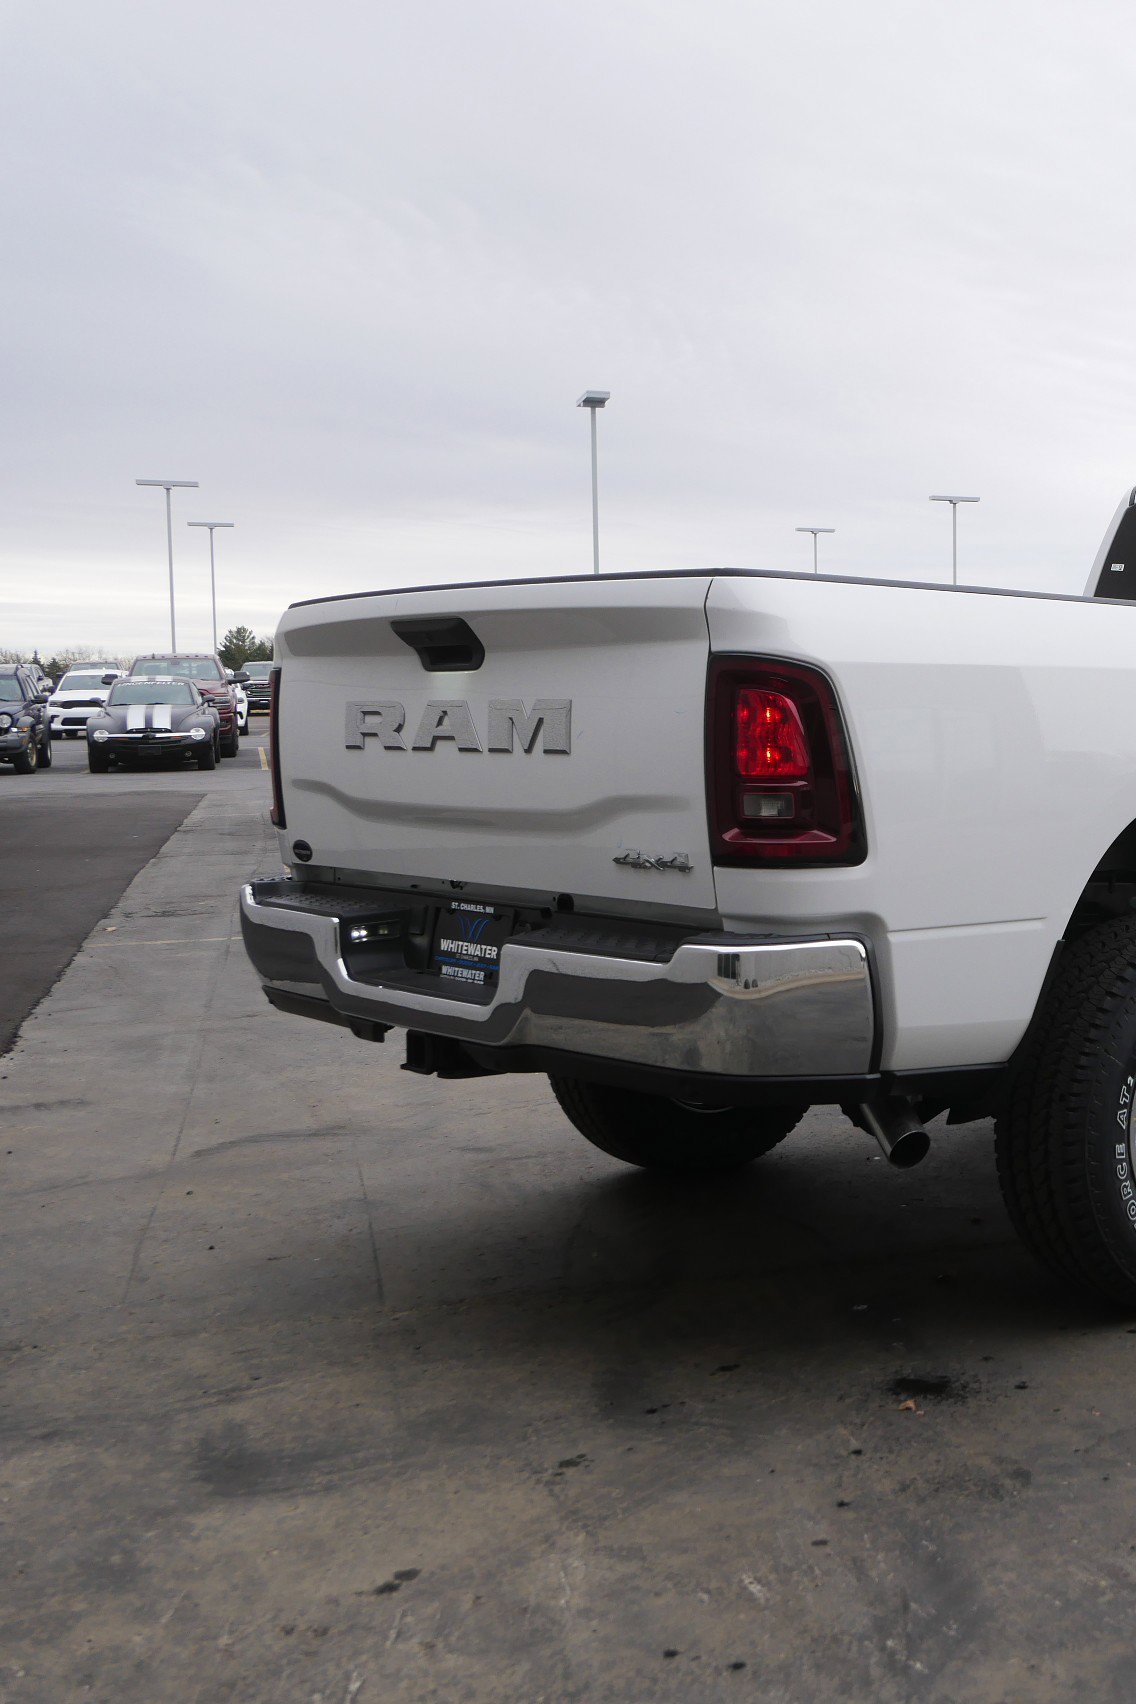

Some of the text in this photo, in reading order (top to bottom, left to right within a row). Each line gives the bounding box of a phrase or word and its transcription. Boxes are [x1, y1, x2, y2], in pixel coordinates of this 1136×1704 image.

[345, 699, 573, 754] RAM
[451, 902, 494, 914] ST. CHARLES, MN
[440, 938, 498, 959] WHITEWATER
[441, 965, 485, 981] WHITEWATER
